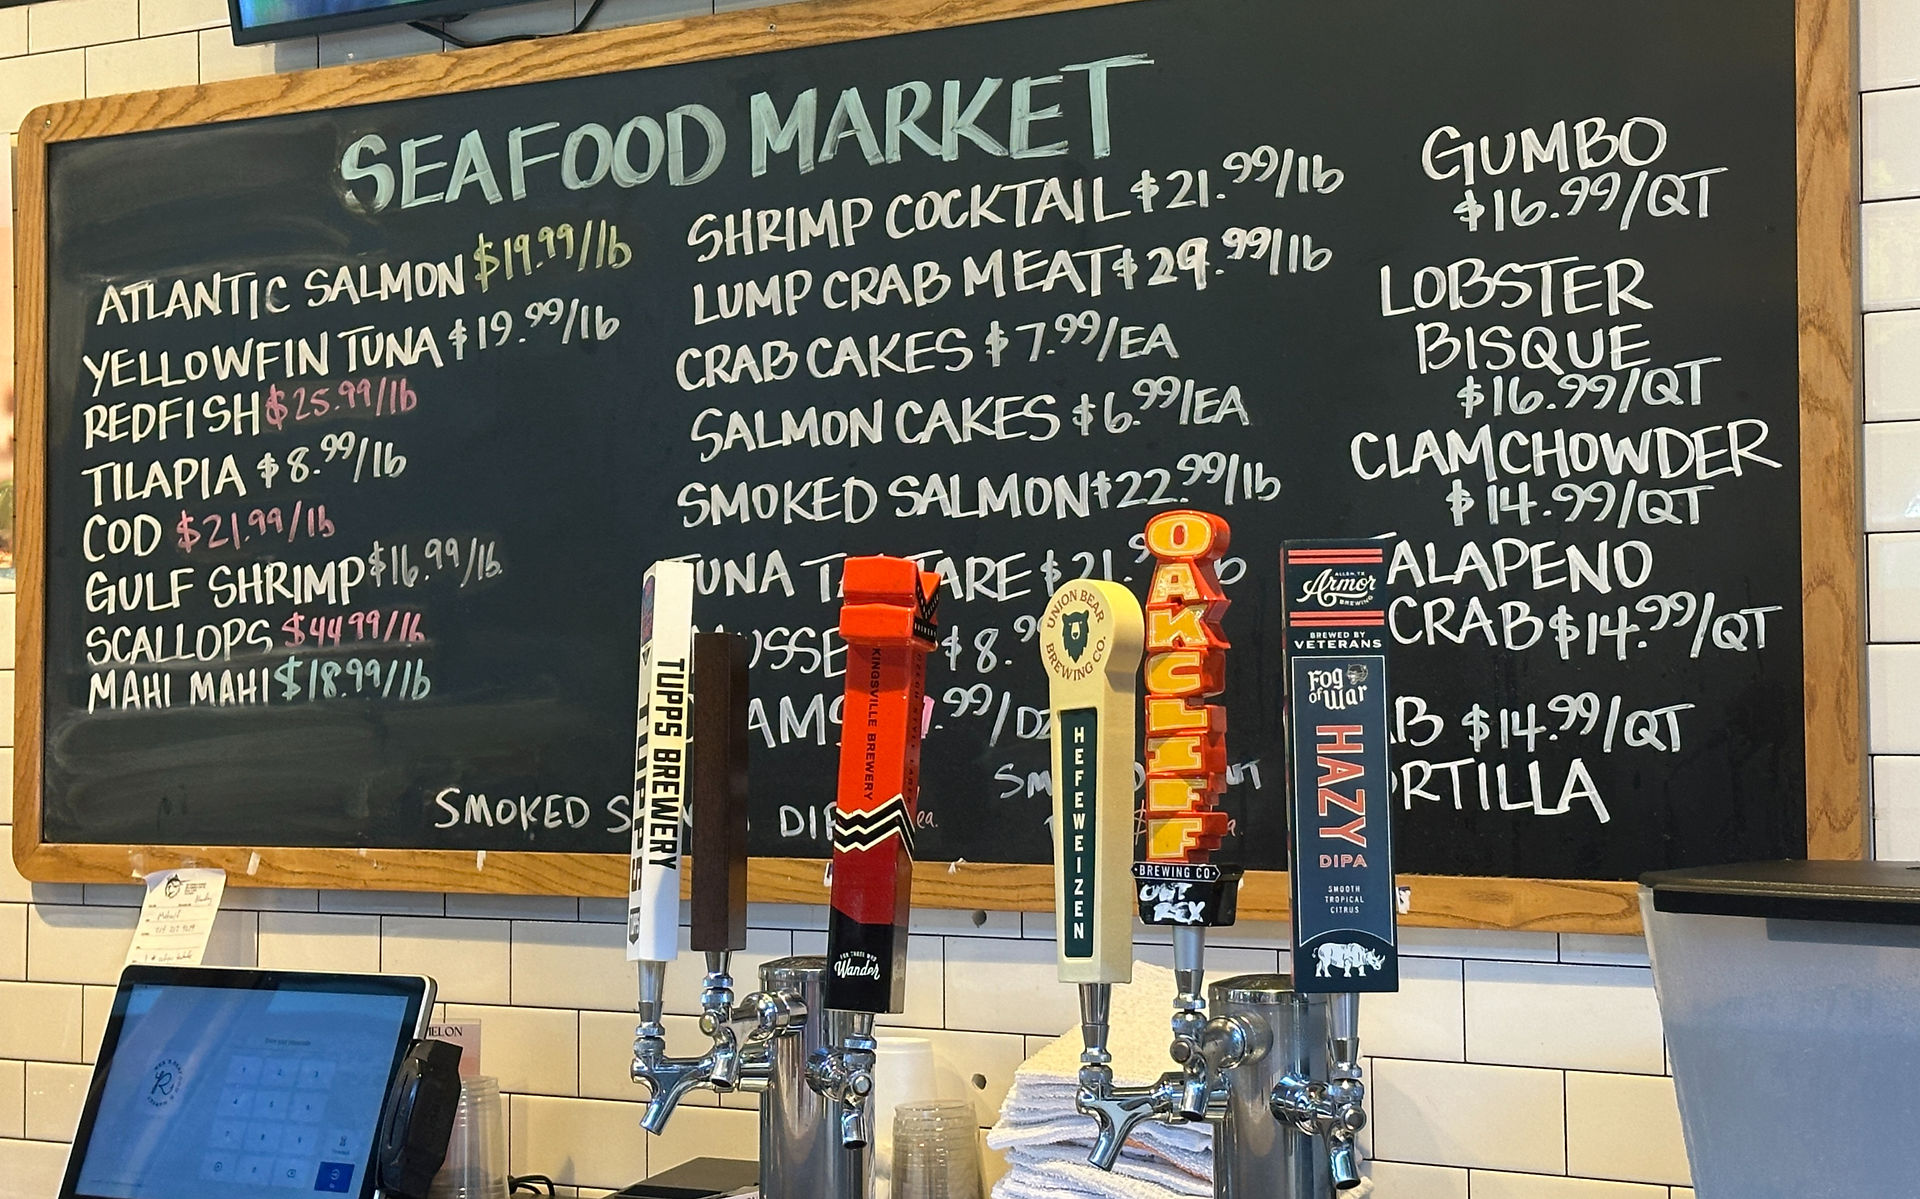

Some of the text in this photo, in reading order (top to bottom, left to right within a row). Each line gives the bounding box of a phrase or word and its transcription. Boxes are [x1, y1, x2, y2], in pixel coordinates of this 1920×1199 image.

[341, 53, 1155, 213] SEAFOOD MARKET
[1421, 116, 1667, 186] GUMBO
[687, 196, 873, 264] SHRIMP
[884, 175, 1132, 240] COCKTAIL
[96, 271, 291, 326] ATLANTIC
[304, 254, 465, 308] SALMON
[692, 267, 813, 326] LUMP
[822, 259, 951, 313] CRAB
[962, 243, 1124, 298] MEAT
[1380, 256, 1654, 318] LOBSTER
[82, 331, 328, 397] YELLOWFIN
[337, 325, 443, 380] TUNA
[675, 339, 798, 392] CRAB
[806, 327, 973, 379] CAKES
[1415, 321, 1652, 376] BISQUE
[83, 391, 260, 450] REDFISH
[691, 397, 884, 463] SALMON
[895, 391, 1061, 444] CAKES
[82, 454, 248, 507] TILAPIA
[677, 475, 878, 530] SMOKED
[888, 471, 1090, 520] SALMON
[83, 513, 162, 562] COD
[1370, 531, 1653, 594] ALAPENO
[85, 567, 195, 615] GULF
[208, 556, 365, 606] SHRIMP
[664, 551, 795, 598] UNA
[1296, 568, 1376, 607] Armor
[1339, 595, 1373, 606] BREWING
[1047, 589, 1105, 629] UNION BEAR
[1310, 631, 1350, 639] BREWED
[1388, 595, 1544, 652] CRAB
[85, 617, 273, 666] SCALLOPS
[1046, 636, 1106, 681] BREWING CO.
[1294, 639, 1382, 649] VETERANS
[88, 670, 172, 714] MAHI
[189, 667, 270, 707] MAHI
[863, 648, 881, 800] KINGSVILLE BREWERY
[649, 658, 685, 870] TUPPS BREWERY
[1316, 725, 1367, 848] HAZY
[1391, 757, 1610, 824] RTILLA
[434, 787, 591, 830] SMOKED
[1072, 726, 1086, 940] HEFEWEIZEN
[1139, 864, 1210, 879] BREWING CO
[1319, 854, 1367, 868] DIPA
[1328, 885, 1361, 893] SMOOTH
[1325, 896, 1364, 904] TROPICAL
[1330, 906, 1360, 914] CITRUS
[834, 957, 881, 980] Wander
